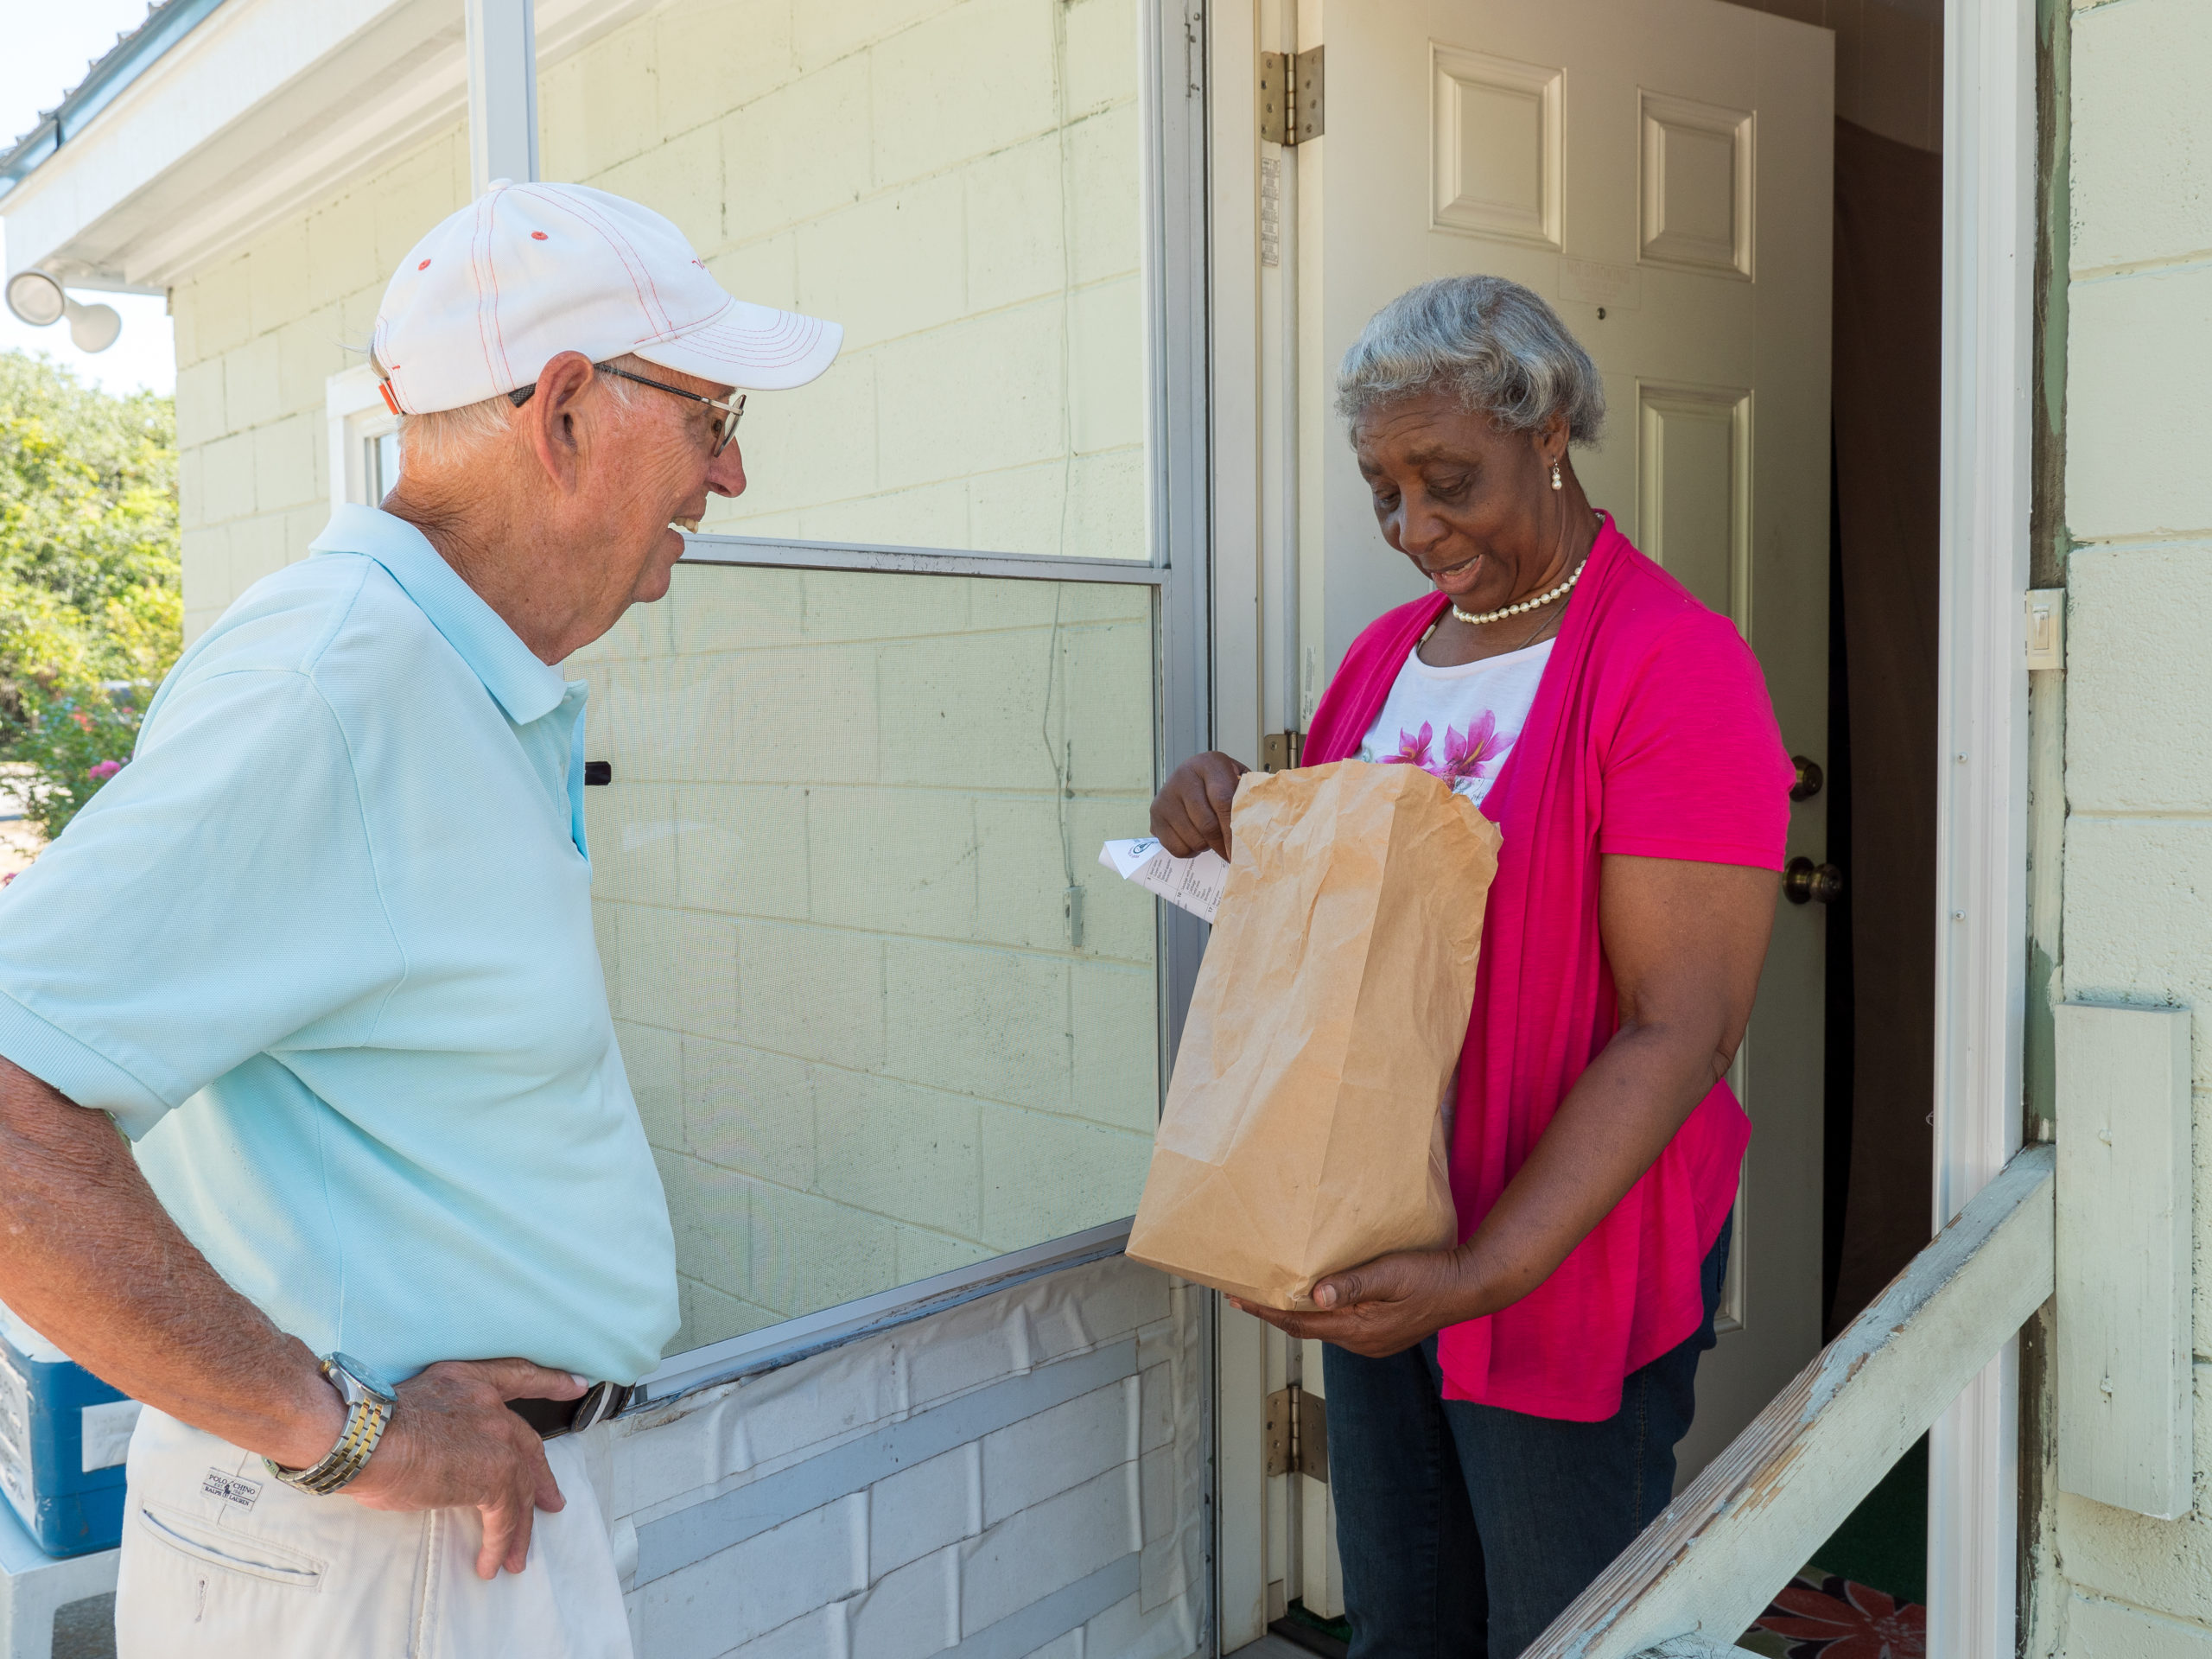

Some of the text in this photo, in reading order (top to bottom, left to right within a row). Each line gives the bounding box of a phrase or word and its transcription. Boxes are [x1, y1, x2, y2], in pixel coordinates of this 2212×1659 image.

[209, 1474, 255, 1494] POLO CHINO
[205, 1486, 250, 1506] RALPH LAUREN
